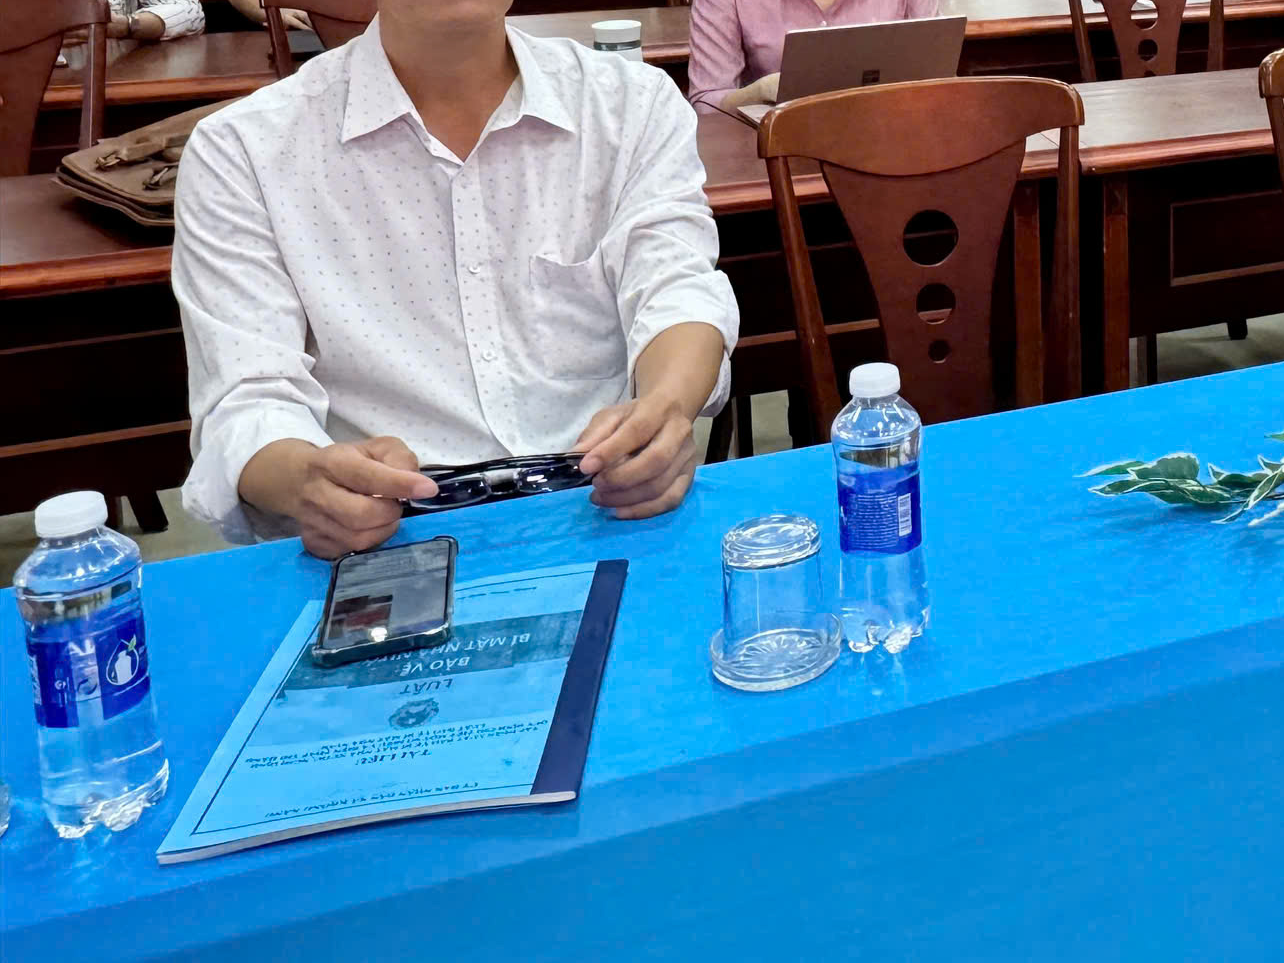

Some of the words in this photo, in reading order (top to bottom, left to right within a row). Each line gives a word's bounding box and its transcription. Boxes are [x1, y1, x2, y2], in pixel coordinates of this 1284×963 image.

[464, 636, 506, 653] MẬT
[511, 633, 531, 646] BÍ
[400, 663, 424, 677] VỆ
[429, 656, 471, 671] BẢO
[400, 678, 454, 695] LUẬT
